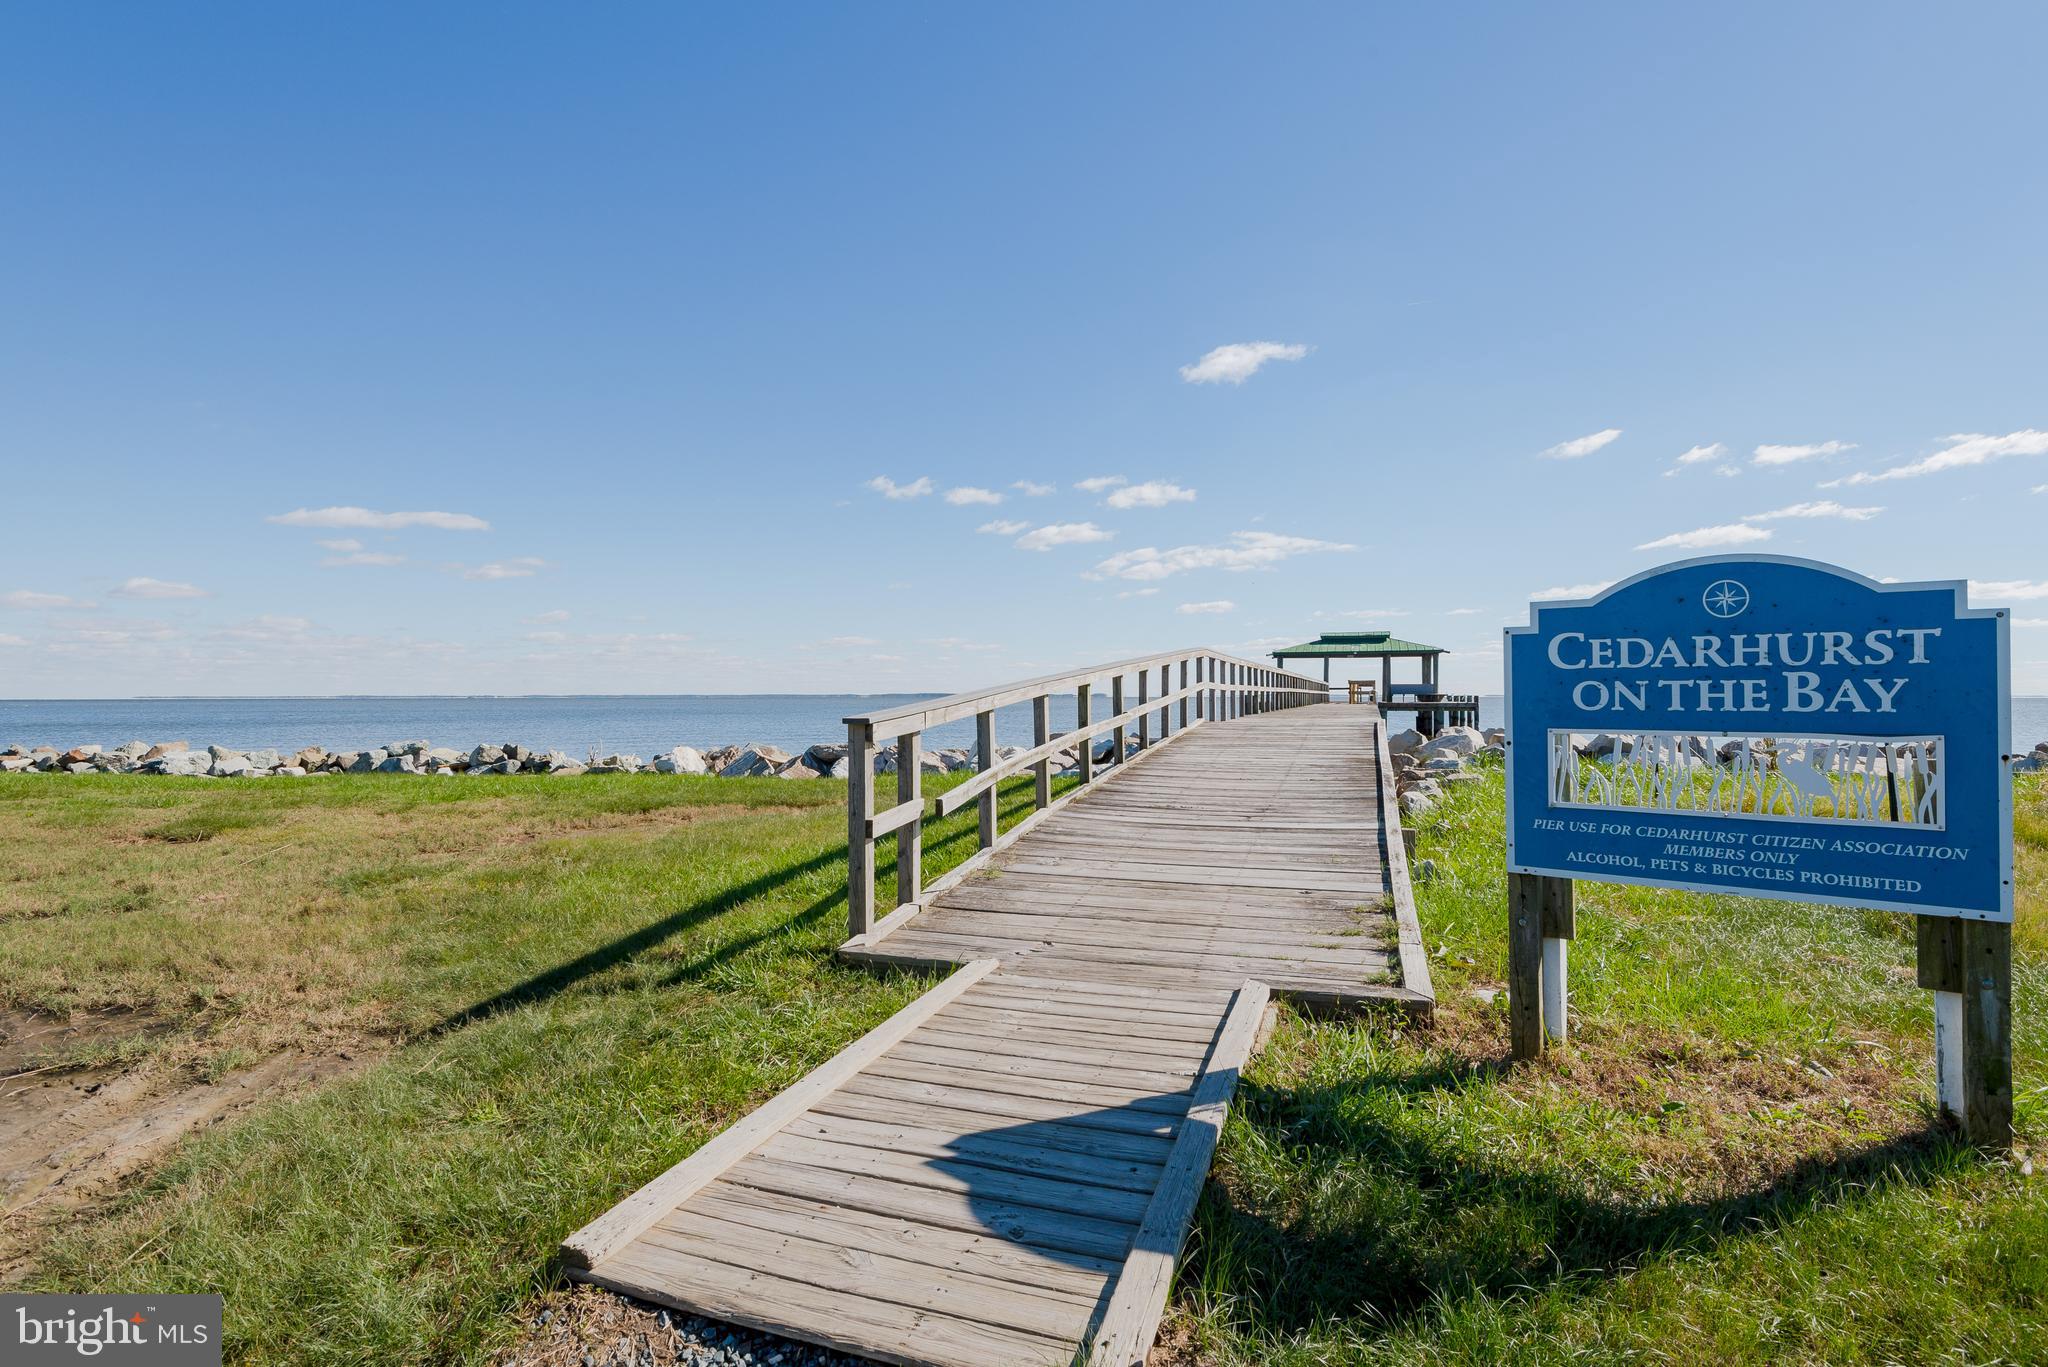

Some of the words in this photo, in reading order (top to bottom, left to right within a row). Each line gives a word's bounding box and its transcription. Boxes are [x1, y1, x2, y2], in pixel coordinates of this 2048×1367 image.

[1547, 627, 1942, 670] CEDARHURST
[1572, 679, 1649, 712] ON
[1657, 678, 1771, 712] THE
[1782, 671, 1909, 713] BAY
[1533, 818, 1565, 831] PIER
[1569, 821, 1597, 833] USE
[1600, 823, 1631, 836] FOR
[1635, 826, 1748, 844] CEDARHURST
[1752, 834, 1826, 850] CITIZEN
[1830, 839, 1969, 861] ASSOCIATION
[1663, 844, 1745, 861] MEMBERS
[1750, 850, 1800, 865] ONLY
[1566, 851, 1646, 870] ALCOHOL,
[1650, 858, 1689, 872] PETS
[1694, 862, 1707, 873] &
[1712, 863, 1795, 882] BICYCLES
[1800, 871, 1921, 893] PROHIBITED
